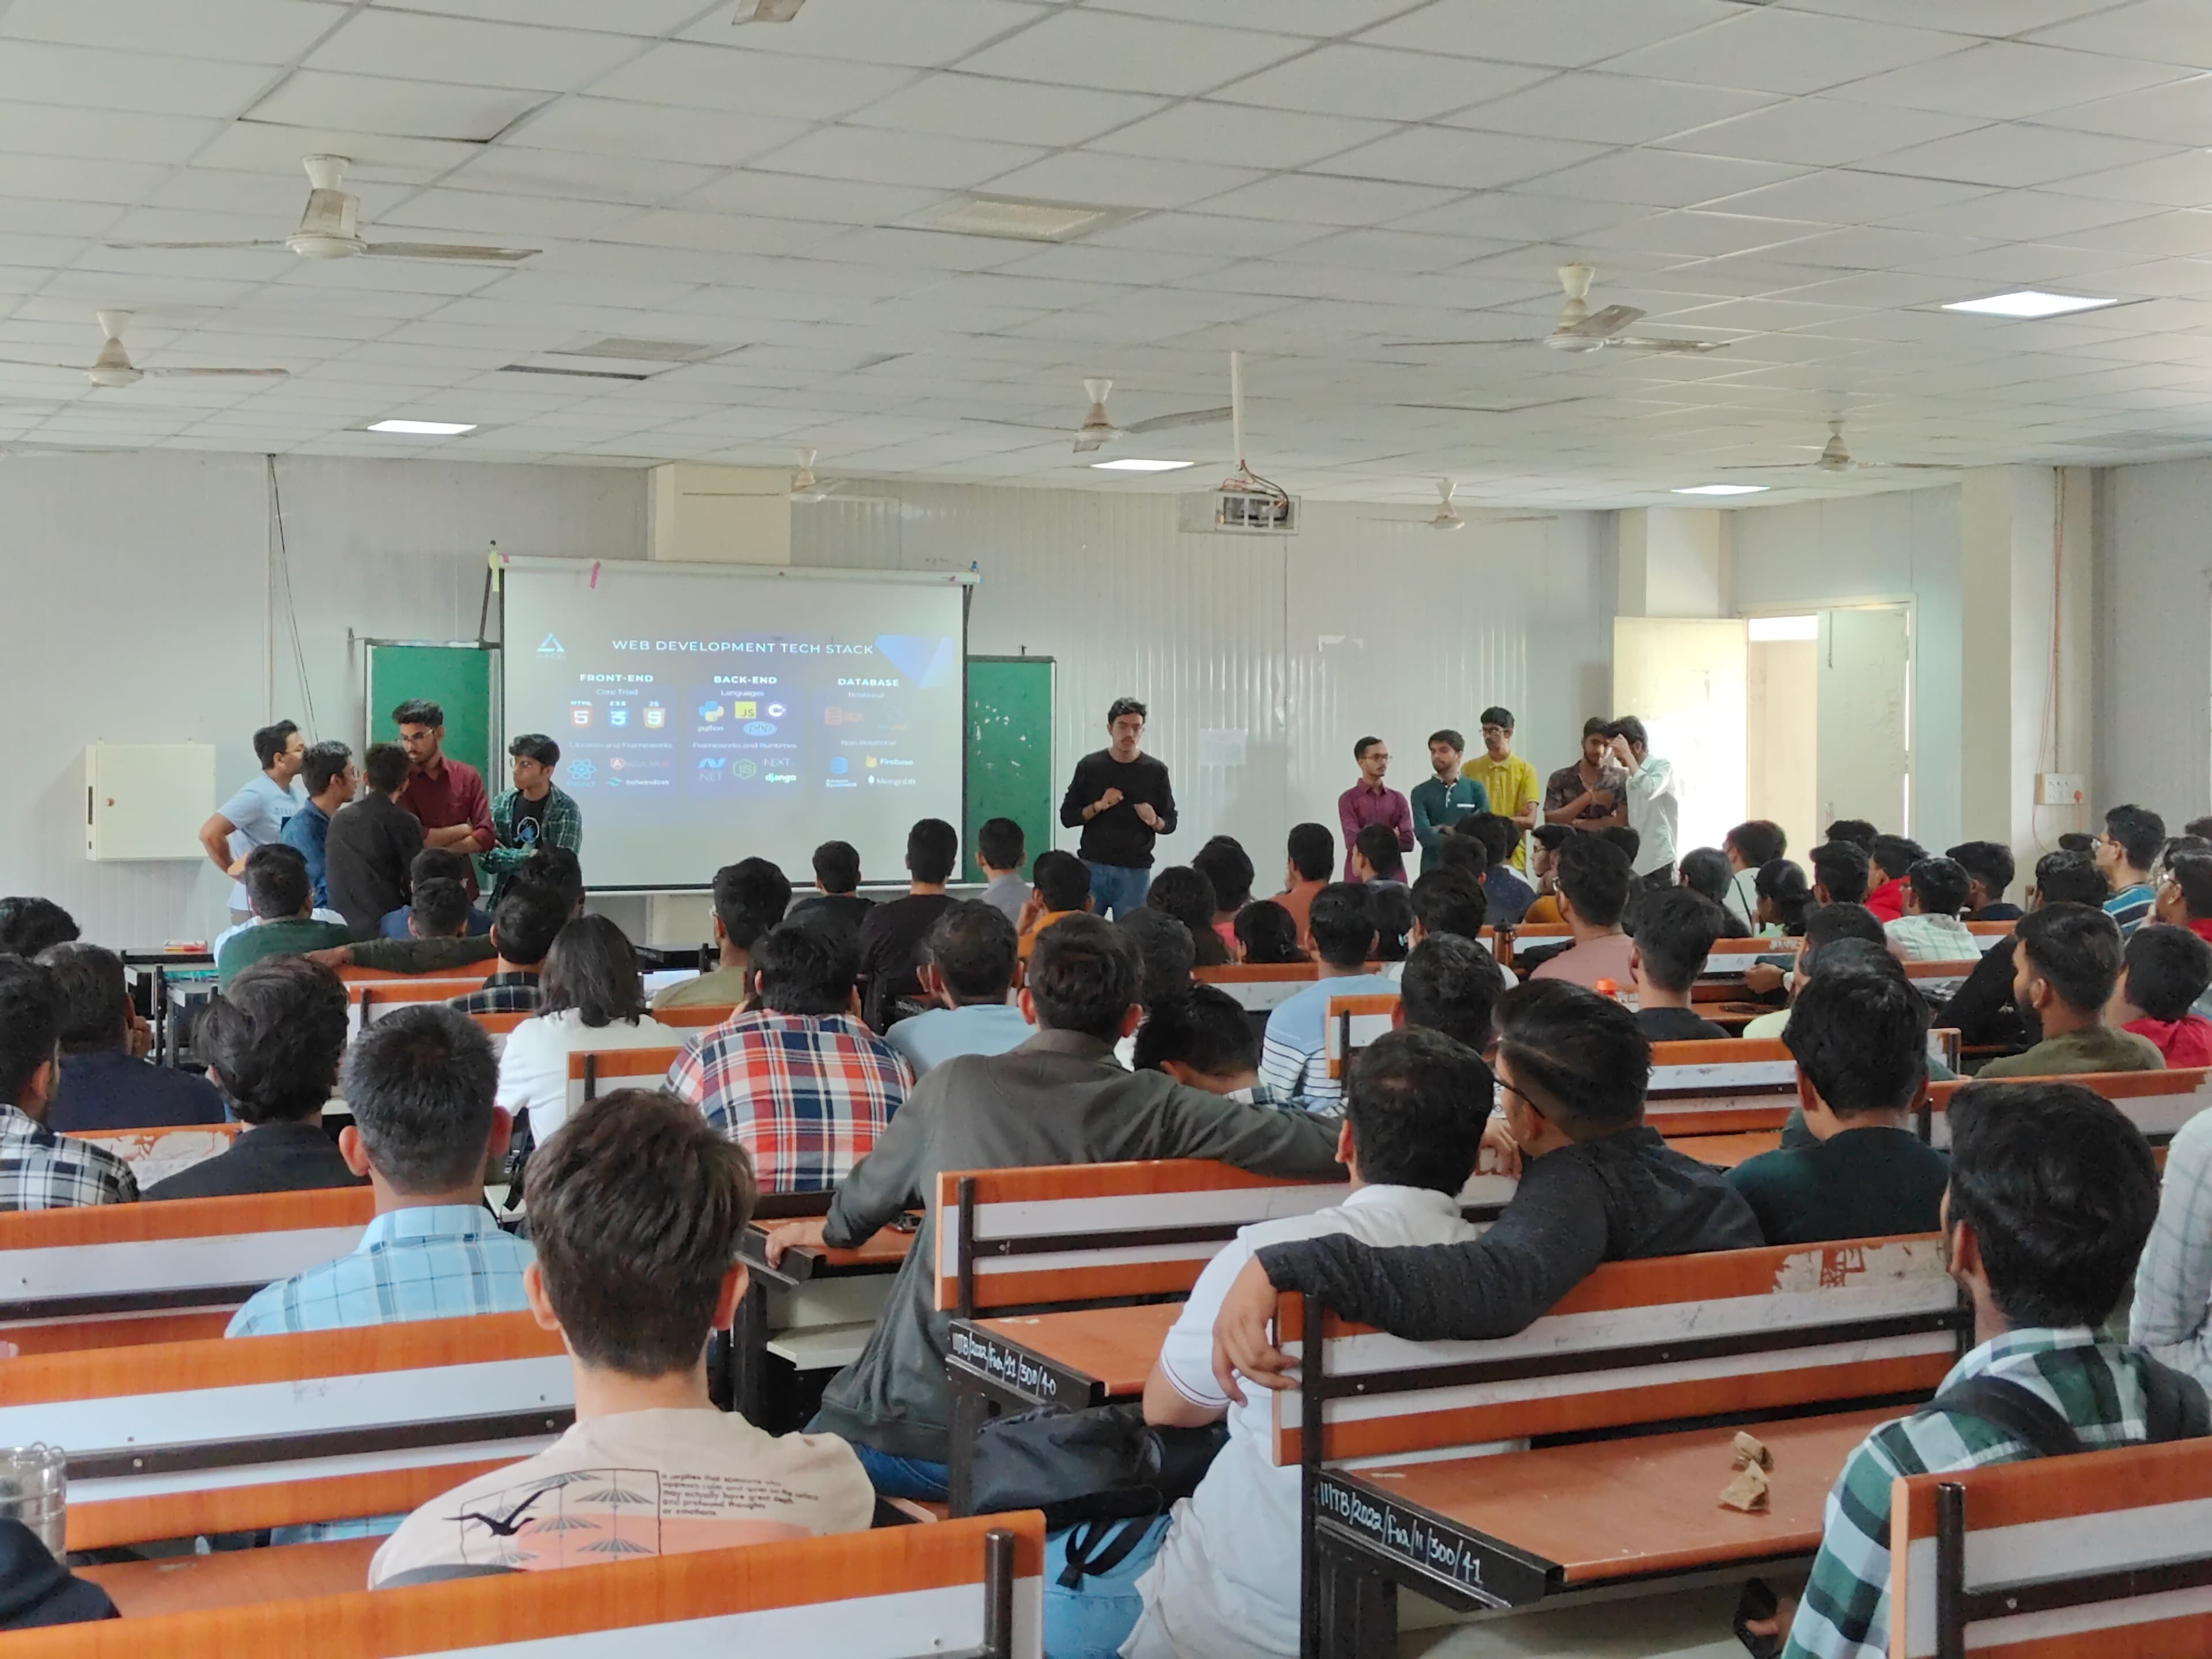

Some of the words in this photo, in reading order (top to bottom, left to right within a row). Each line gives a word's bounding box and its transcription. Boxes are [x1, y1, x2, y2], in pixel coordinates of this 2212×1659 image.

[612, 639, 650, 650] WEB
[656, 640, 776, 653] DEVELOPMENT
[780, 643, 820, 653] TECH
[825, 643, 874, 654] STACK
[579, 673, 654, 683] FRONT-END
[713, 675, 778, 684] BACK-END
[838, 677, 900, 687] DATABASE
[720, 690, 765, 698] Languages
[741, 709, 755, 718] JS
[697, 724, 724, 733] python
[749, 723, 773, 733] php
[764, 772, 797, 783] django
